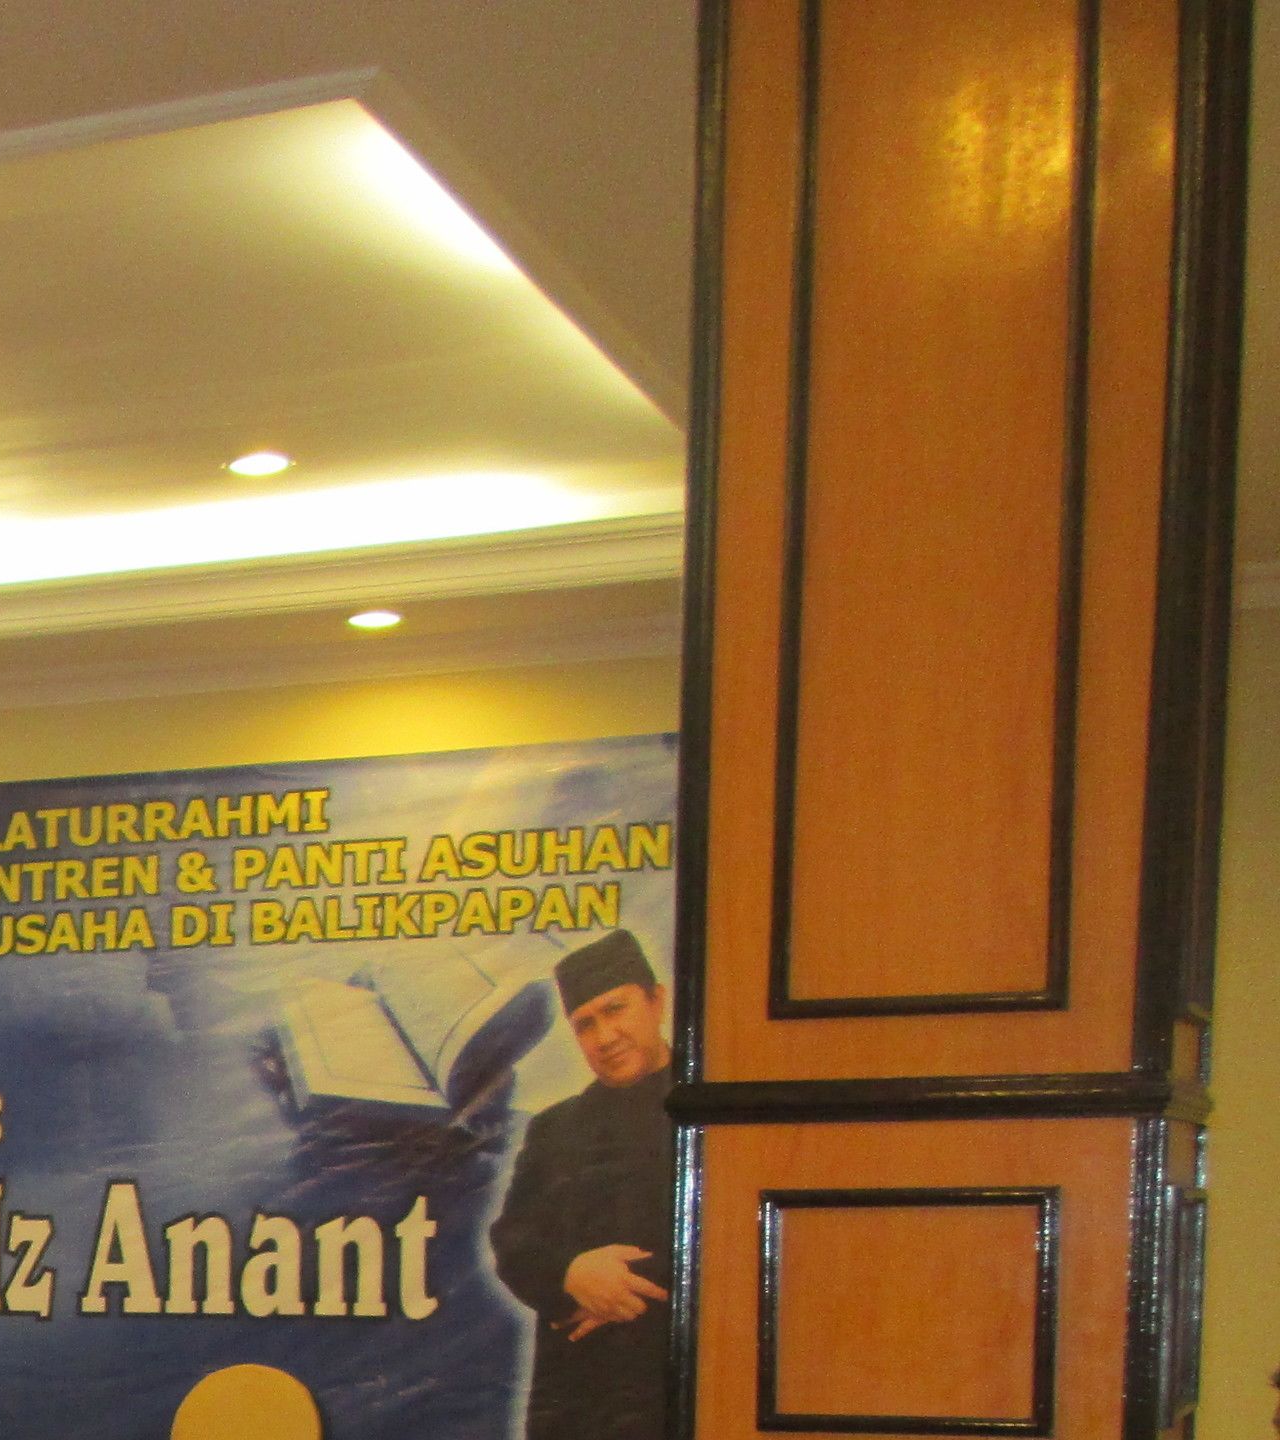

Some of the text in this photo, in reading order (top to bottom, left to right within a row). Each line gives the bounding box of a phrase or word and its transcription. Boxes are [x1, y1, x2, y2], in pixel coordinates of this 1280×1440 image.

[176, 851, 218, 893] &
[233, 838, 407, 891] PANTI
[421, 822, 672, 881] ASUHAN
[171, 904, 233, 947] DI
[251, 880, 621, 945] BALIKPAPAN
[81, 1183, 439, 1320] Anant
